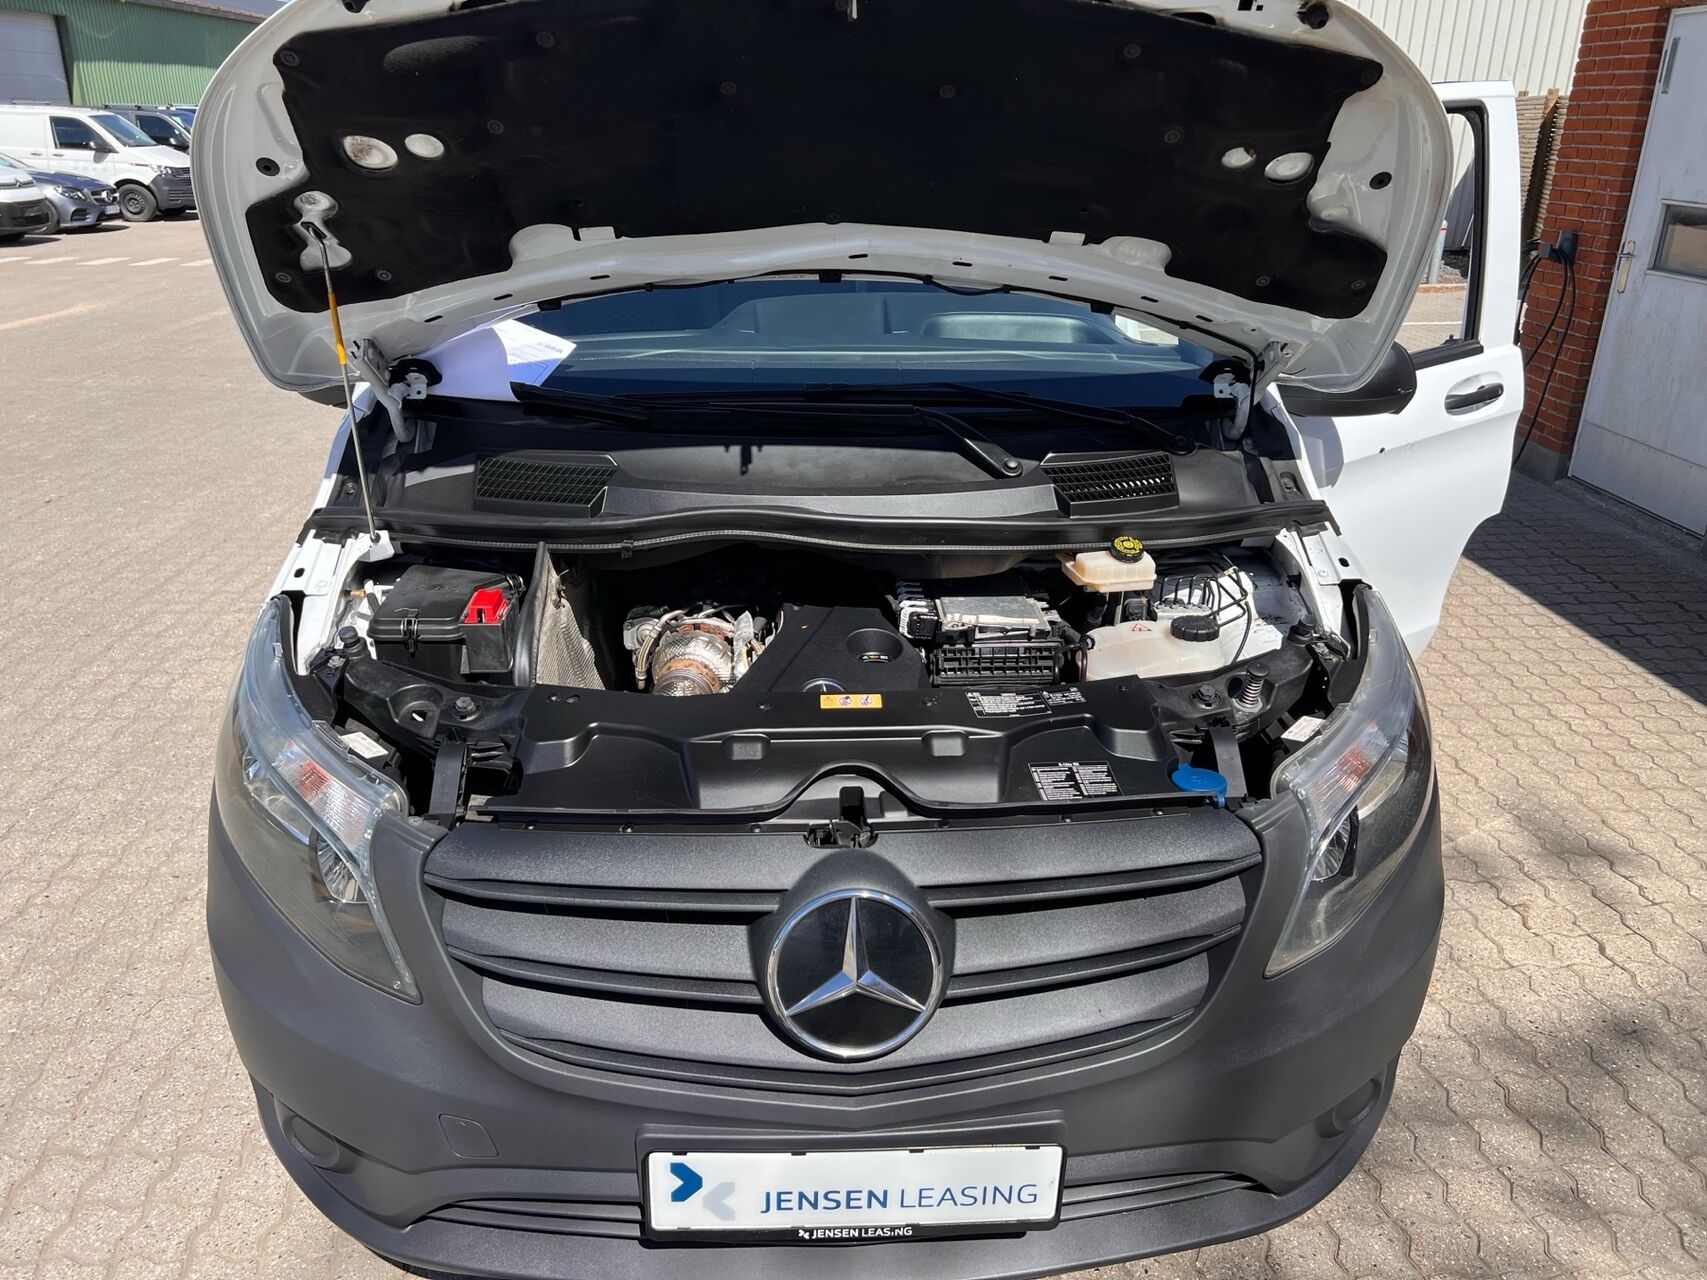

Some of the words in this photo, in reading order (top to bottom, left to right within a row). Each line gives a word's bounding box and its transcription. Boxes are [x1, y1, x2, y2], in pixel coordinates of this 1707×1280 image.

[760, 1189, 888, 1213] JENSEN
[900, 1184, 1038, 1208] LEASING
[812, 1229, 859, 1239] JENSEN
